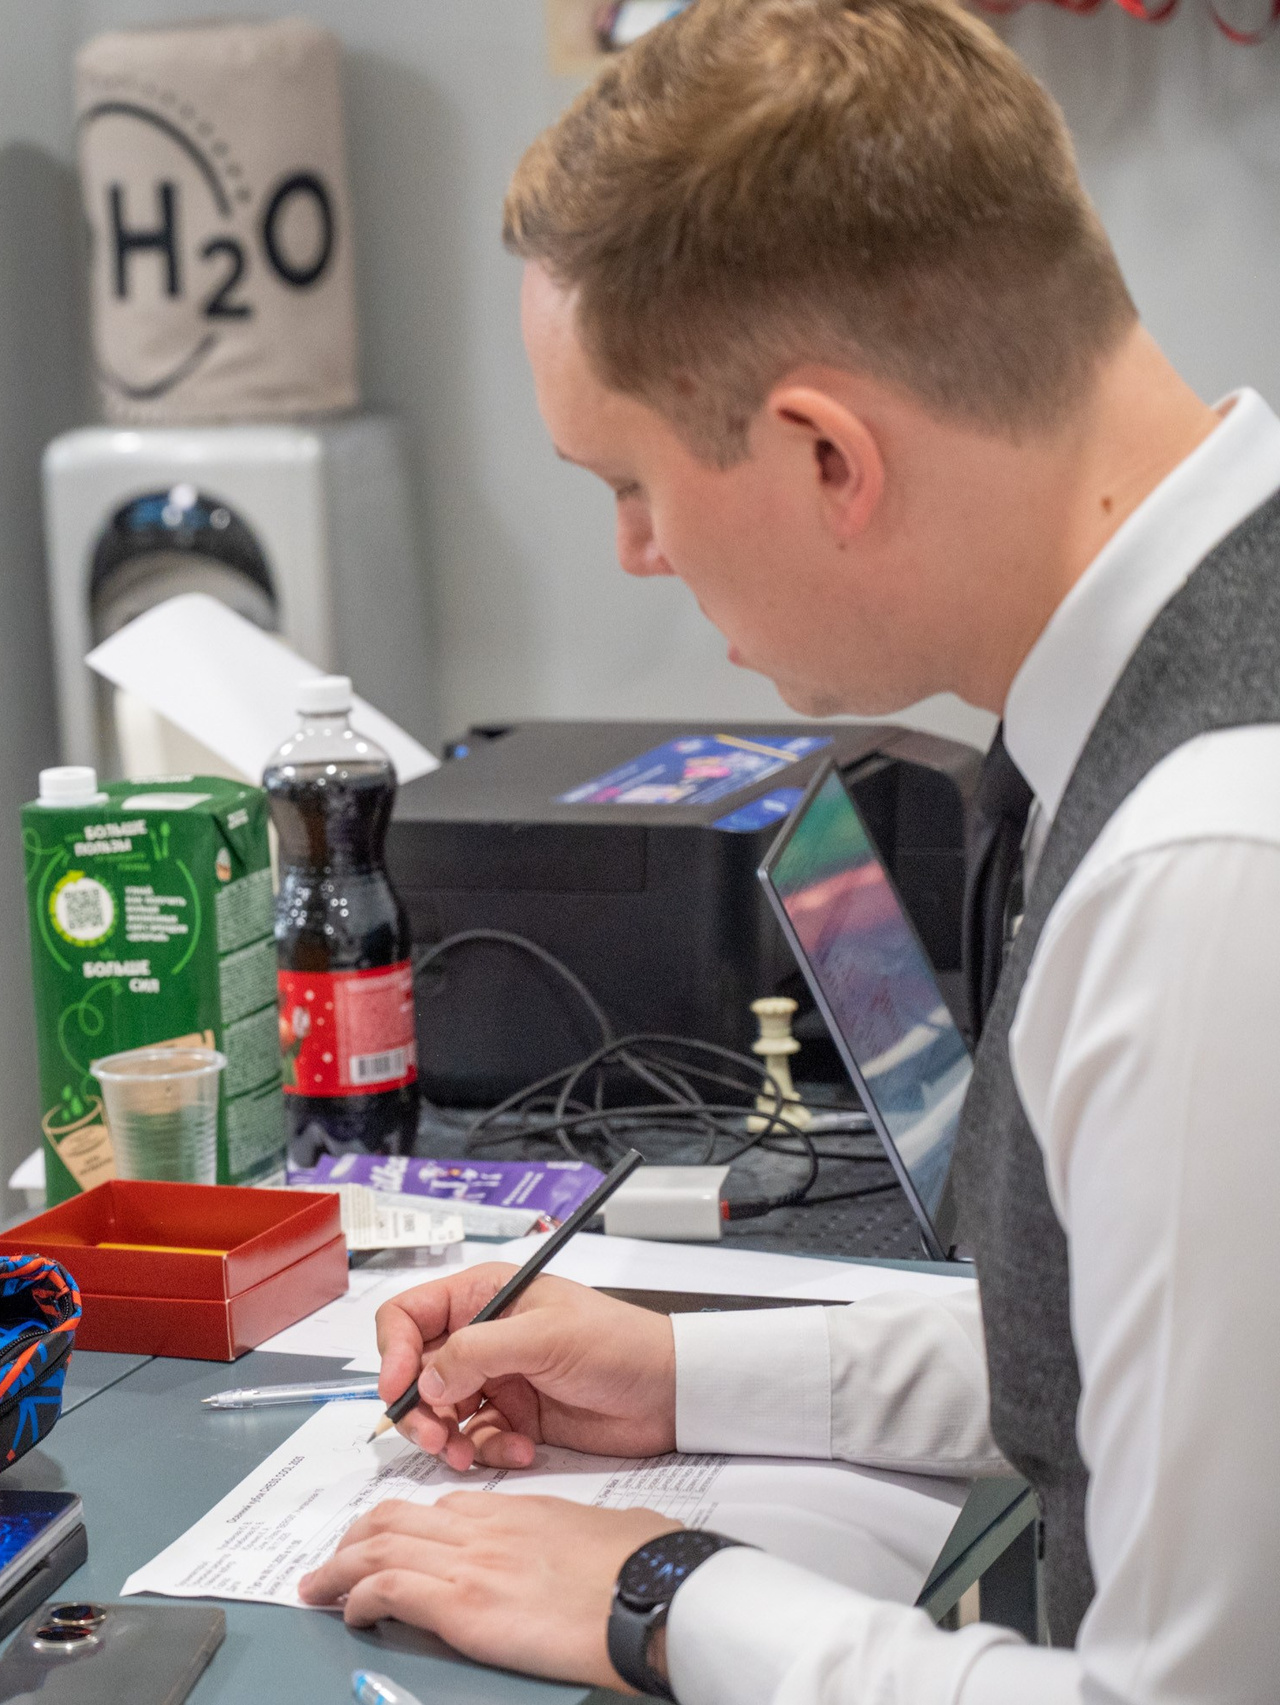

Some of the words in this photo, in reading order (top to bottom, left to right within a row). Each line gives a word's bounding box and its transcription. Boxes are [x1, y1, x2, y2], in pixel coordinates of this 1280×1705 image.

[107, 169, 334, 321] H2O
[83, 819, 147, 841] БОЛЬШЕ
[82, 959, 151, 978] БОЛЬШЕ
[129, 977, 160, 993] СИЛ
